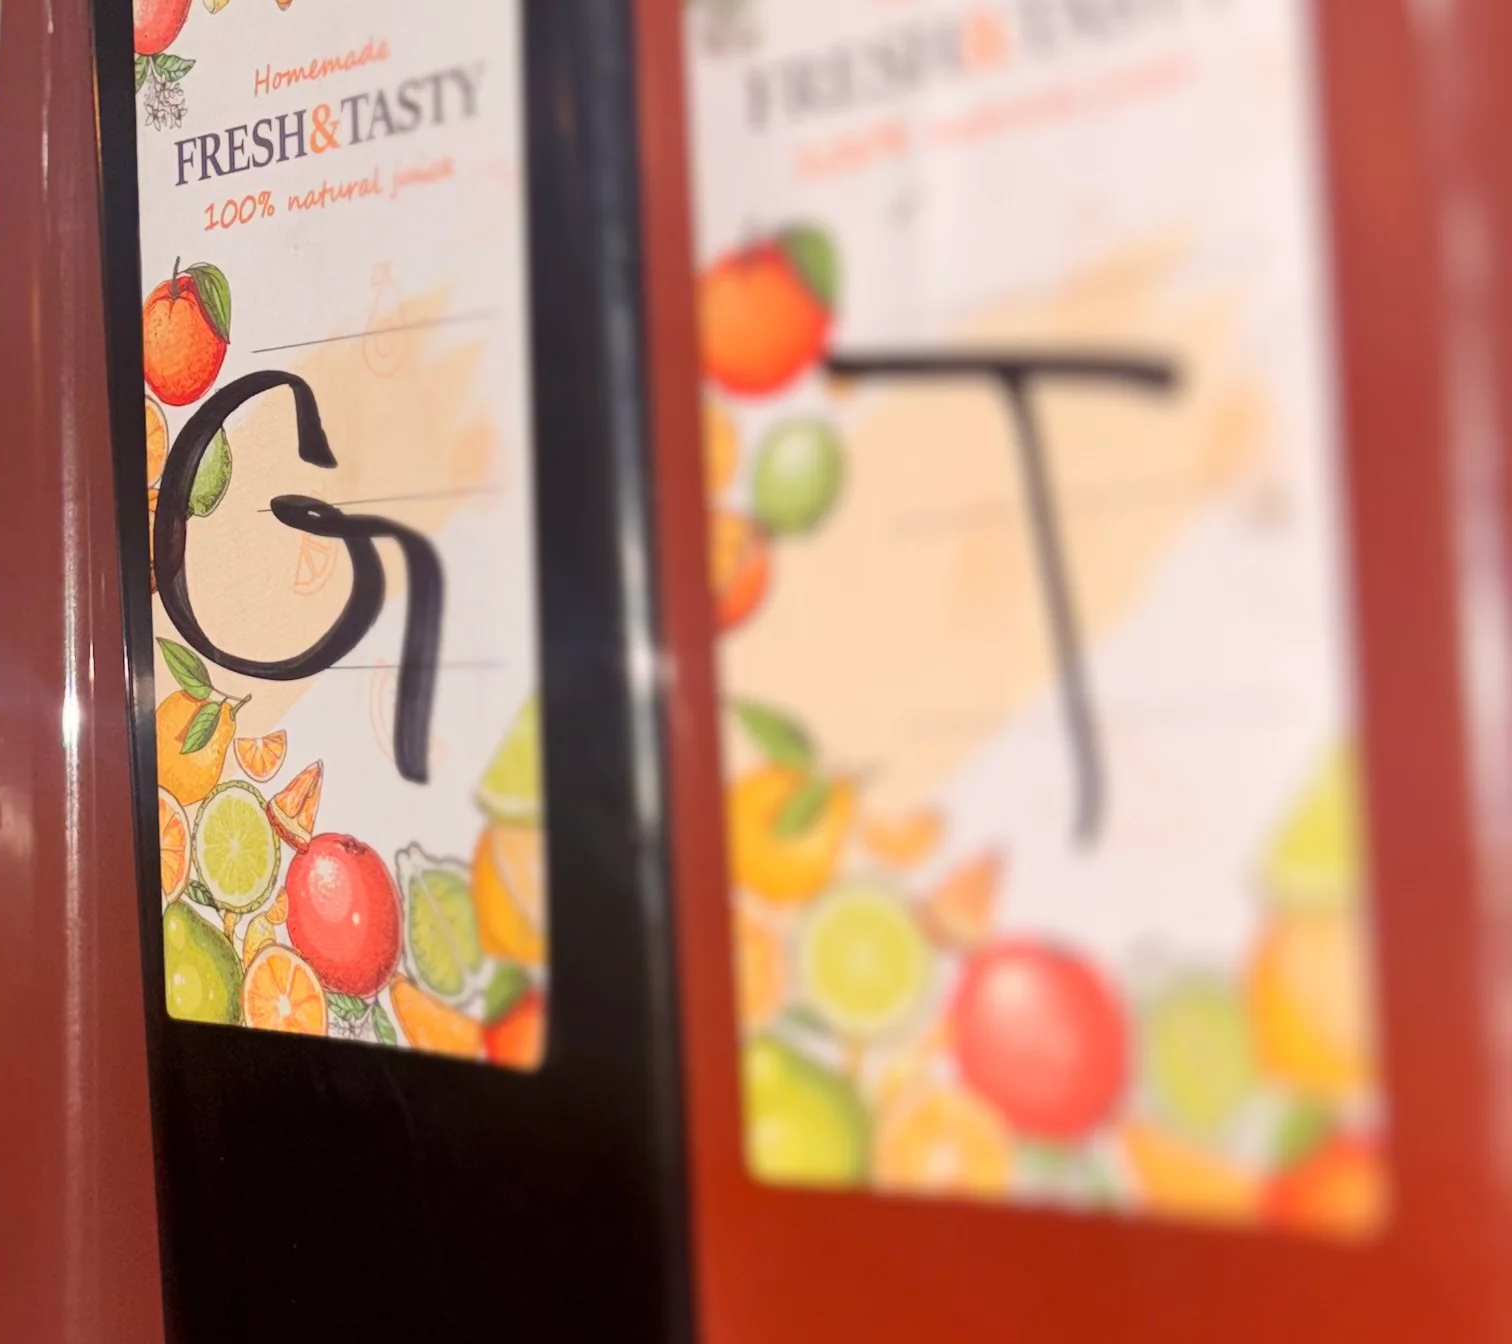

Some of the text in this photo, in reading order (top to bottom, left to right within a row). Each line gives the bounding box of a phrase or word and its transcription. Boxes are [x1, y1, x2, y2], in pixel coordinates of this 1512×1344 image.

[174, 59, 486, 186] FRESH&TASTY
[253, 36, 391, 98] Homemade
[203, 189, 276, 232] 100%
[287, 165, 382, 212] natural
[154, 369, 445, 786] G
[822, 345, 1190, 852] T
